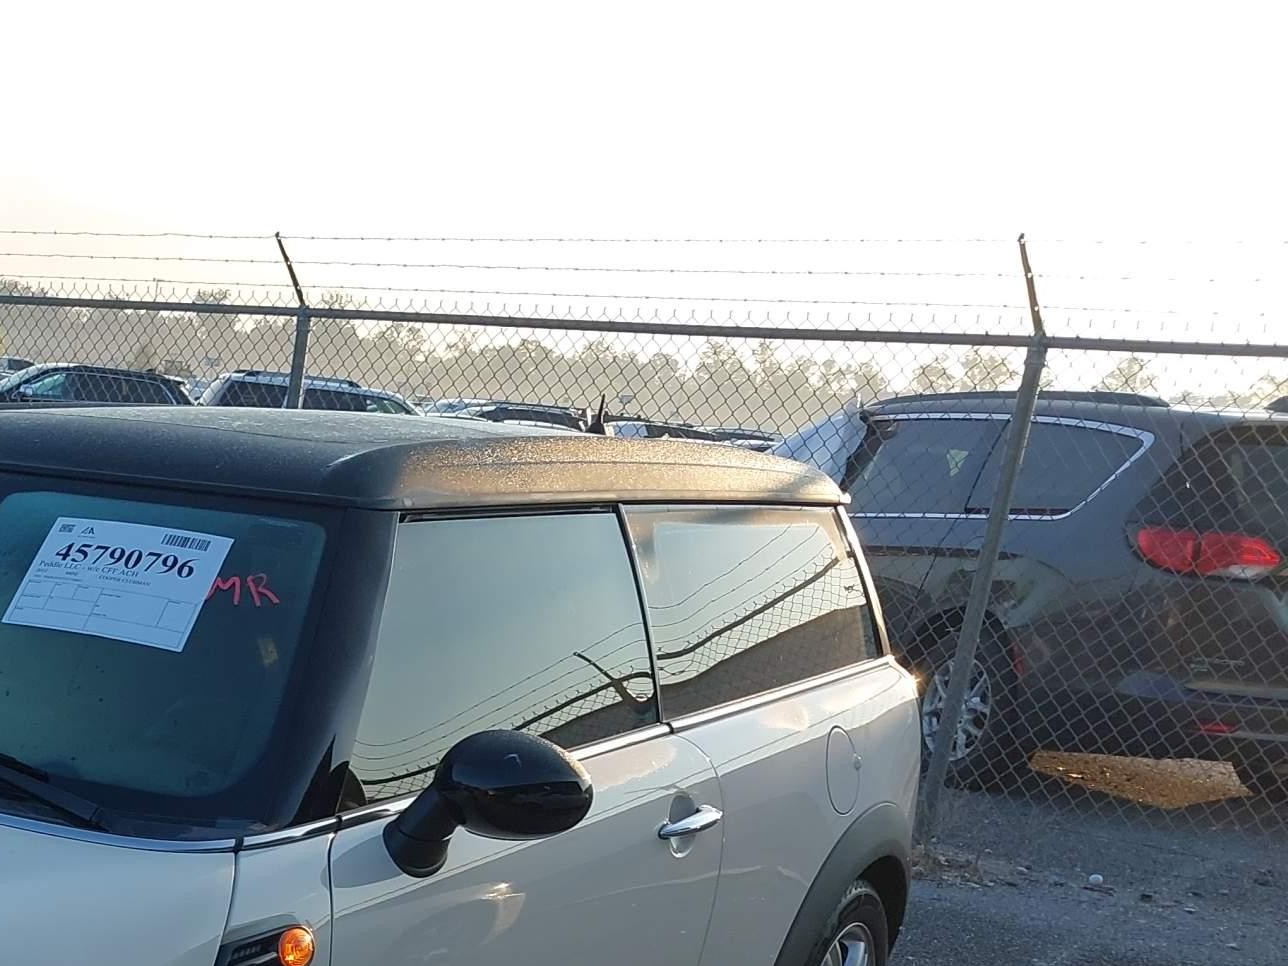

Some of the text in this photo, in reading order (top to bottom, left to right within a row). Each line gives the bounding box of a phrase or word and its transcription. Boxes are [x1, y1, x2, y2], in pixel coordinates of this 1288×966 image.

[55, 542, 200, 579] 45790796
[63, 561, 82, 570] LLC
[119, 568, 140, 578] ACH
[207, 573, 280, 607] MR
